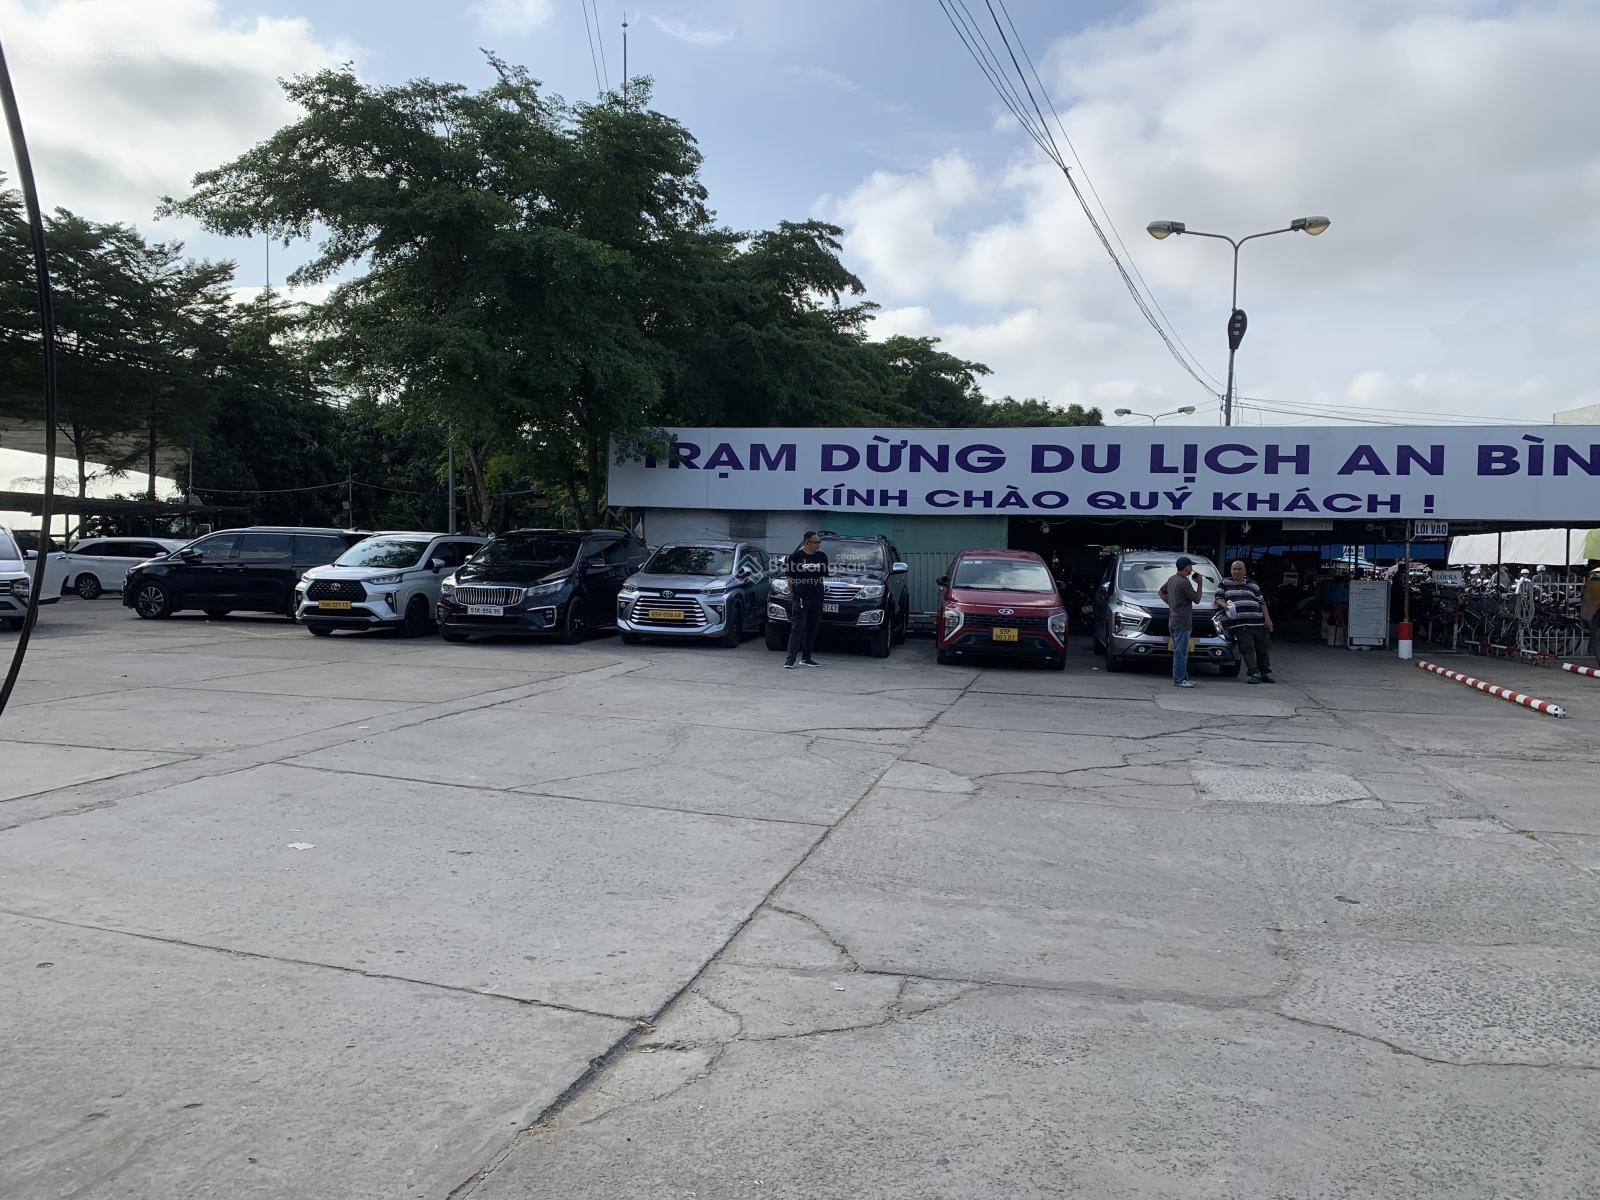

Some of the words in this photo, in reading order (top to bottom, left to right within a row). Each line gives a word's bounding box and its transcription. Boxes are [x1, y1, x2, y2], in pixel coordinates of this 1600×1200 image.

[821, 434, 1006, 474] DỪNG
[1031, 444, 1121, 474] DU
[1150, 444, 1310, 484] LỊCH
[1337, 444, 1444, 476] AN
[1477, 433, 1600, 477] BÌN
[804, 483, 909, 507] KÍNH
[926, 485, 1070, 509] CHÀO
[1087, 486, 1193, 512] QUÝ
[1212, 488, 1401, 514] KHÁCH
[1424, 495, 1435, 514] !
